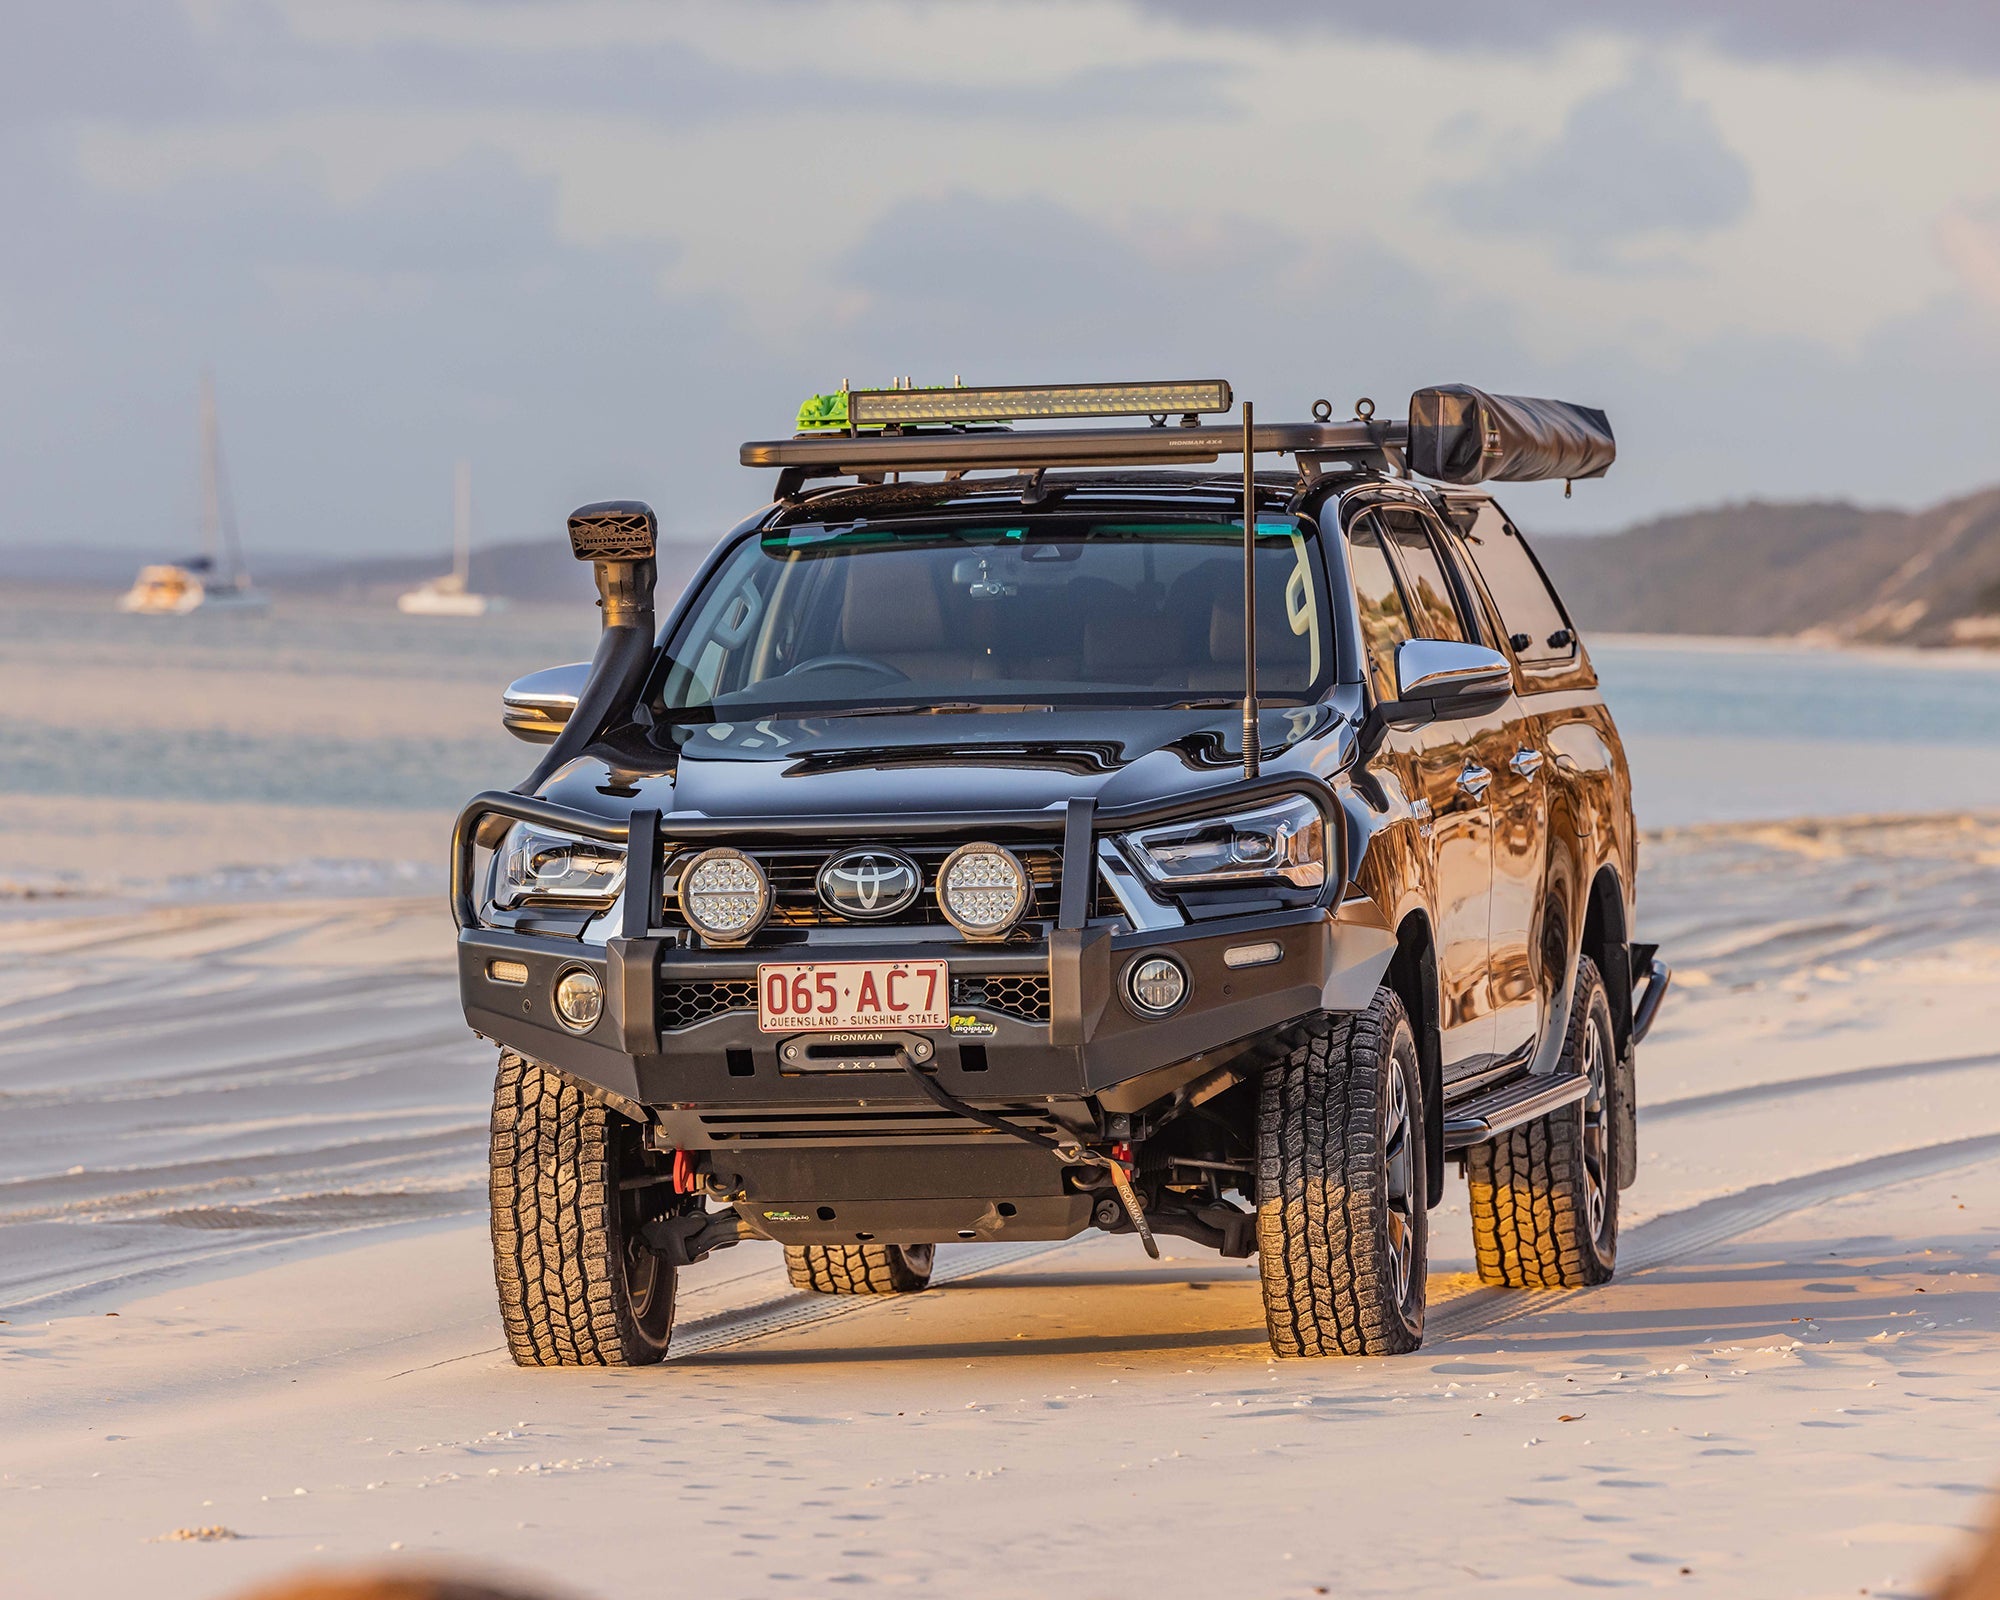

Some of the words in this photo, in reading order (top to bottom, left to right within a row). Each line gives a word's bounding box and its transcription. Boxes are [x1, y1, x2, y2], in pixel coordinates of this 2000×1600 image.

[584, 536, 643, 544] IRONMAN
[770, 1016, 839, 1027] QUEENSLAND
[850, 1015, 903, 1026] SUNSHINE
[908, 1013, 939, 1024] STATE
[1120, 1185, 1143, 1224] IRONMAN
